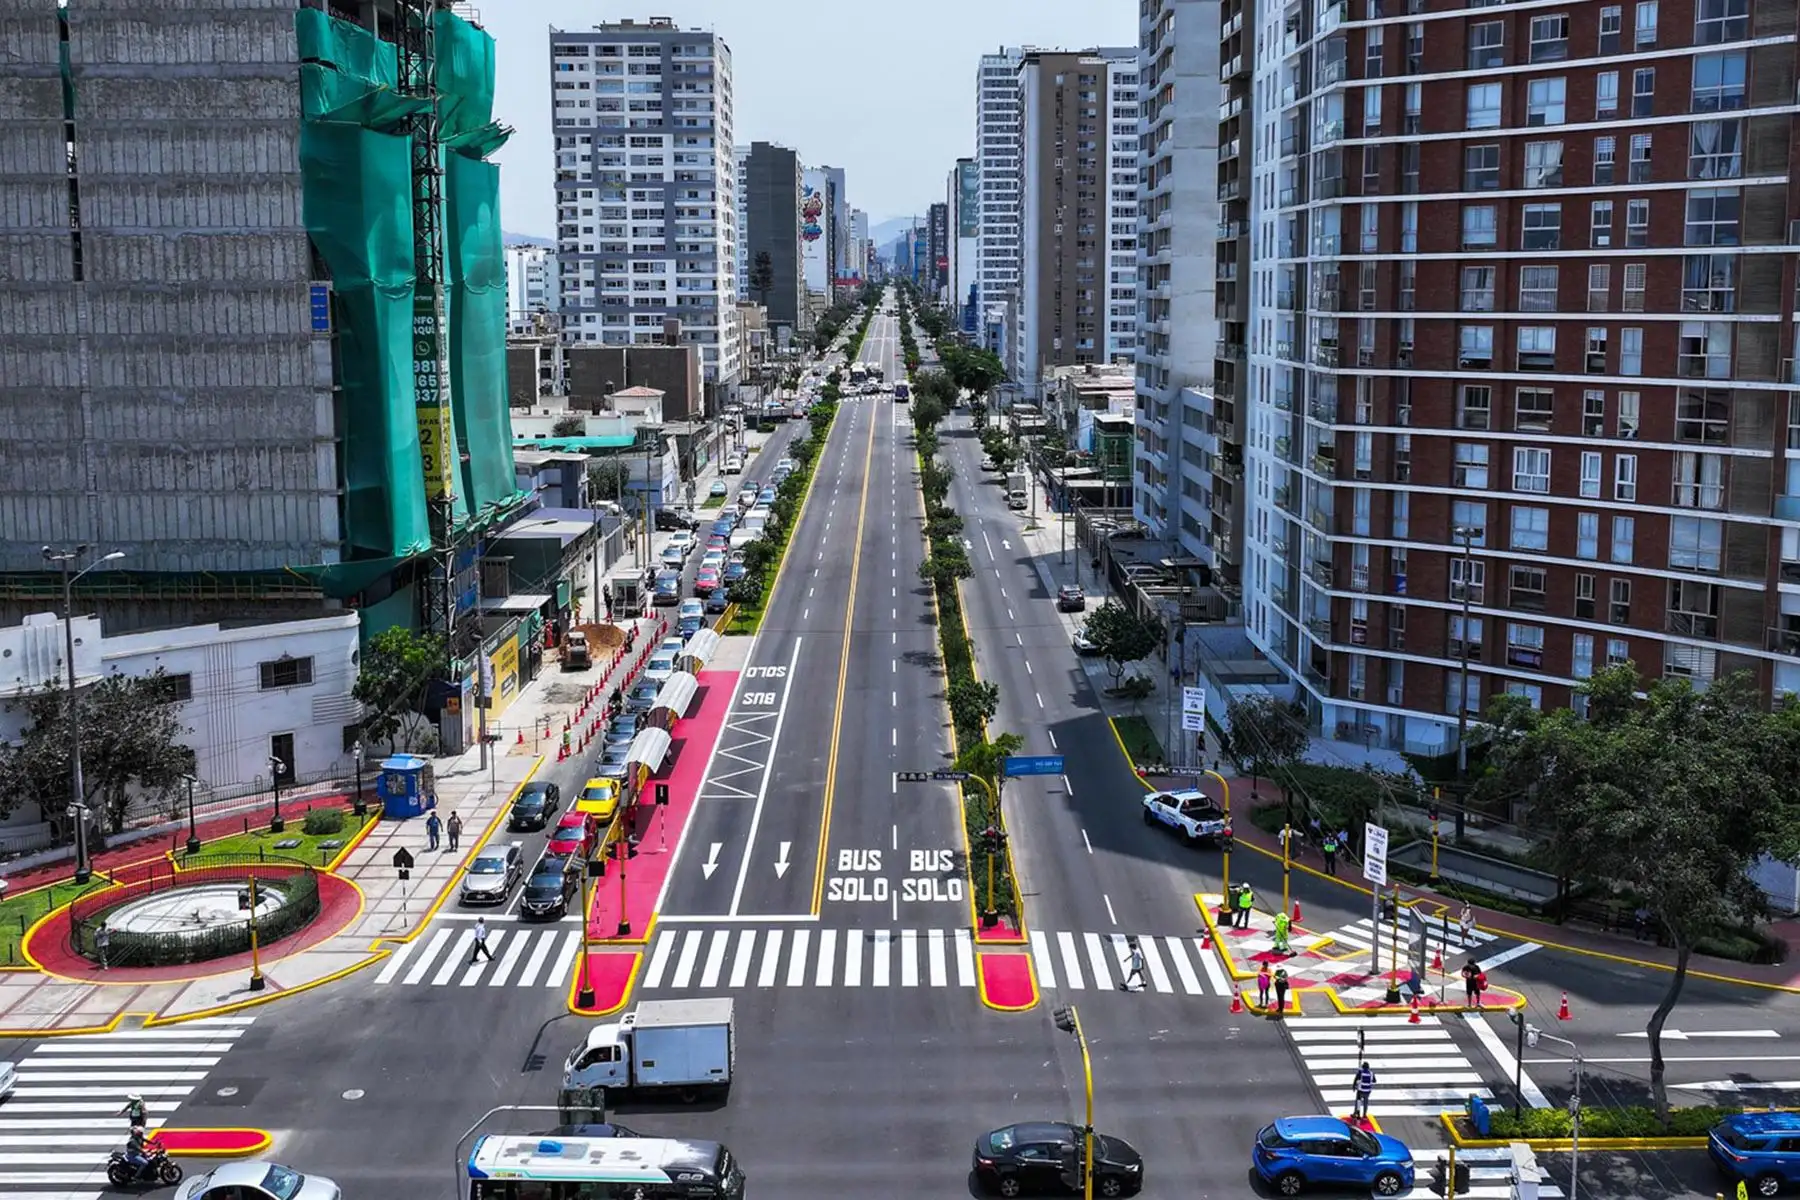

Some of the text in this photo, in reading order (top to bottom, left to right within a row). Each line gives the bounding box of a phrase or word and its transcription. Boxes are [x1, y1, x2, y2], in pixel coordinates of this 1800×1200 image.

[414, 316, 434, 324] NFO
[746, 666, 787, 678] SOLO
[742, 692, 776, 705] BUS
[837, 850, 882, 872] BUS
[909, 850, 954, 872] BUS
[827, 877, 888, 902] SOLO
[902, 878, 963, 902] SOLO
